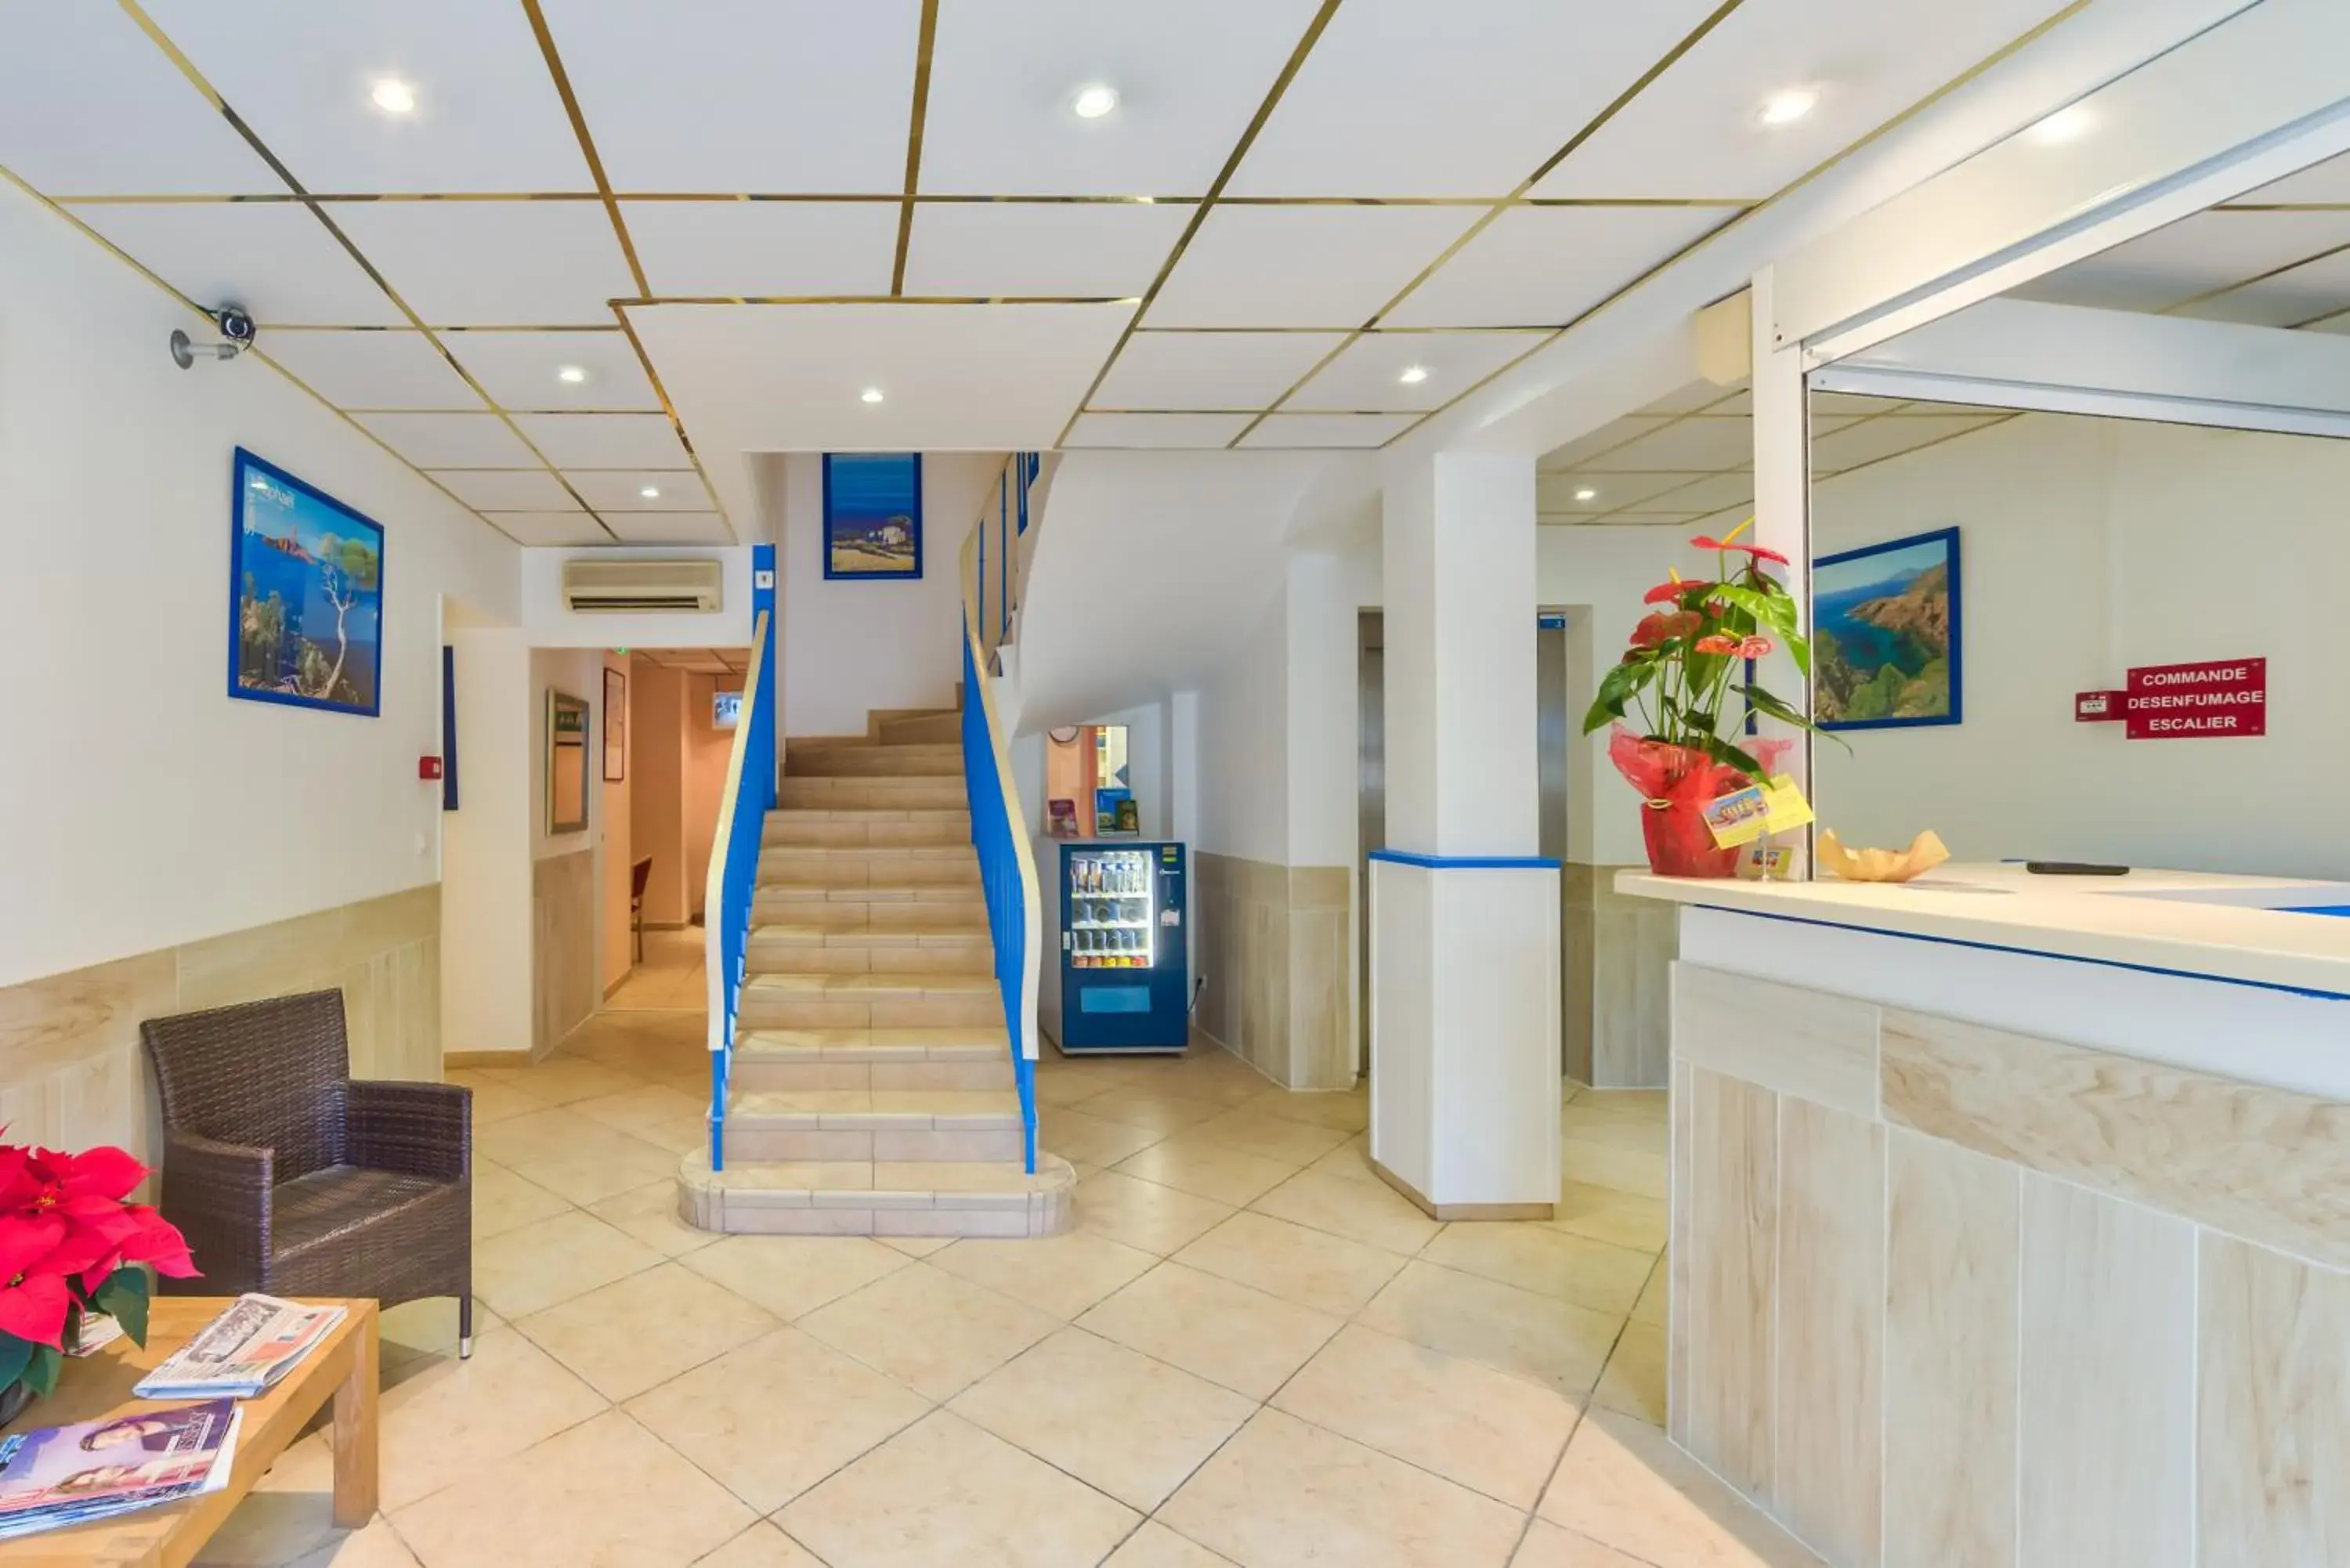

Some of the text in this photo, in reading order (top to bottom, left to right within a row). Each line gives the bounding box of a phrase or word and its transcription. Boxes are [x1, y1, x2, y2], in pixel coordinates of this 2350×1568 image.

[2142, 667, 2247, 686] COMMANDE
[2128, 690, 2263, 710] DESENFUMAGE
[2149, 716, 2238, 731] ESCALIER
